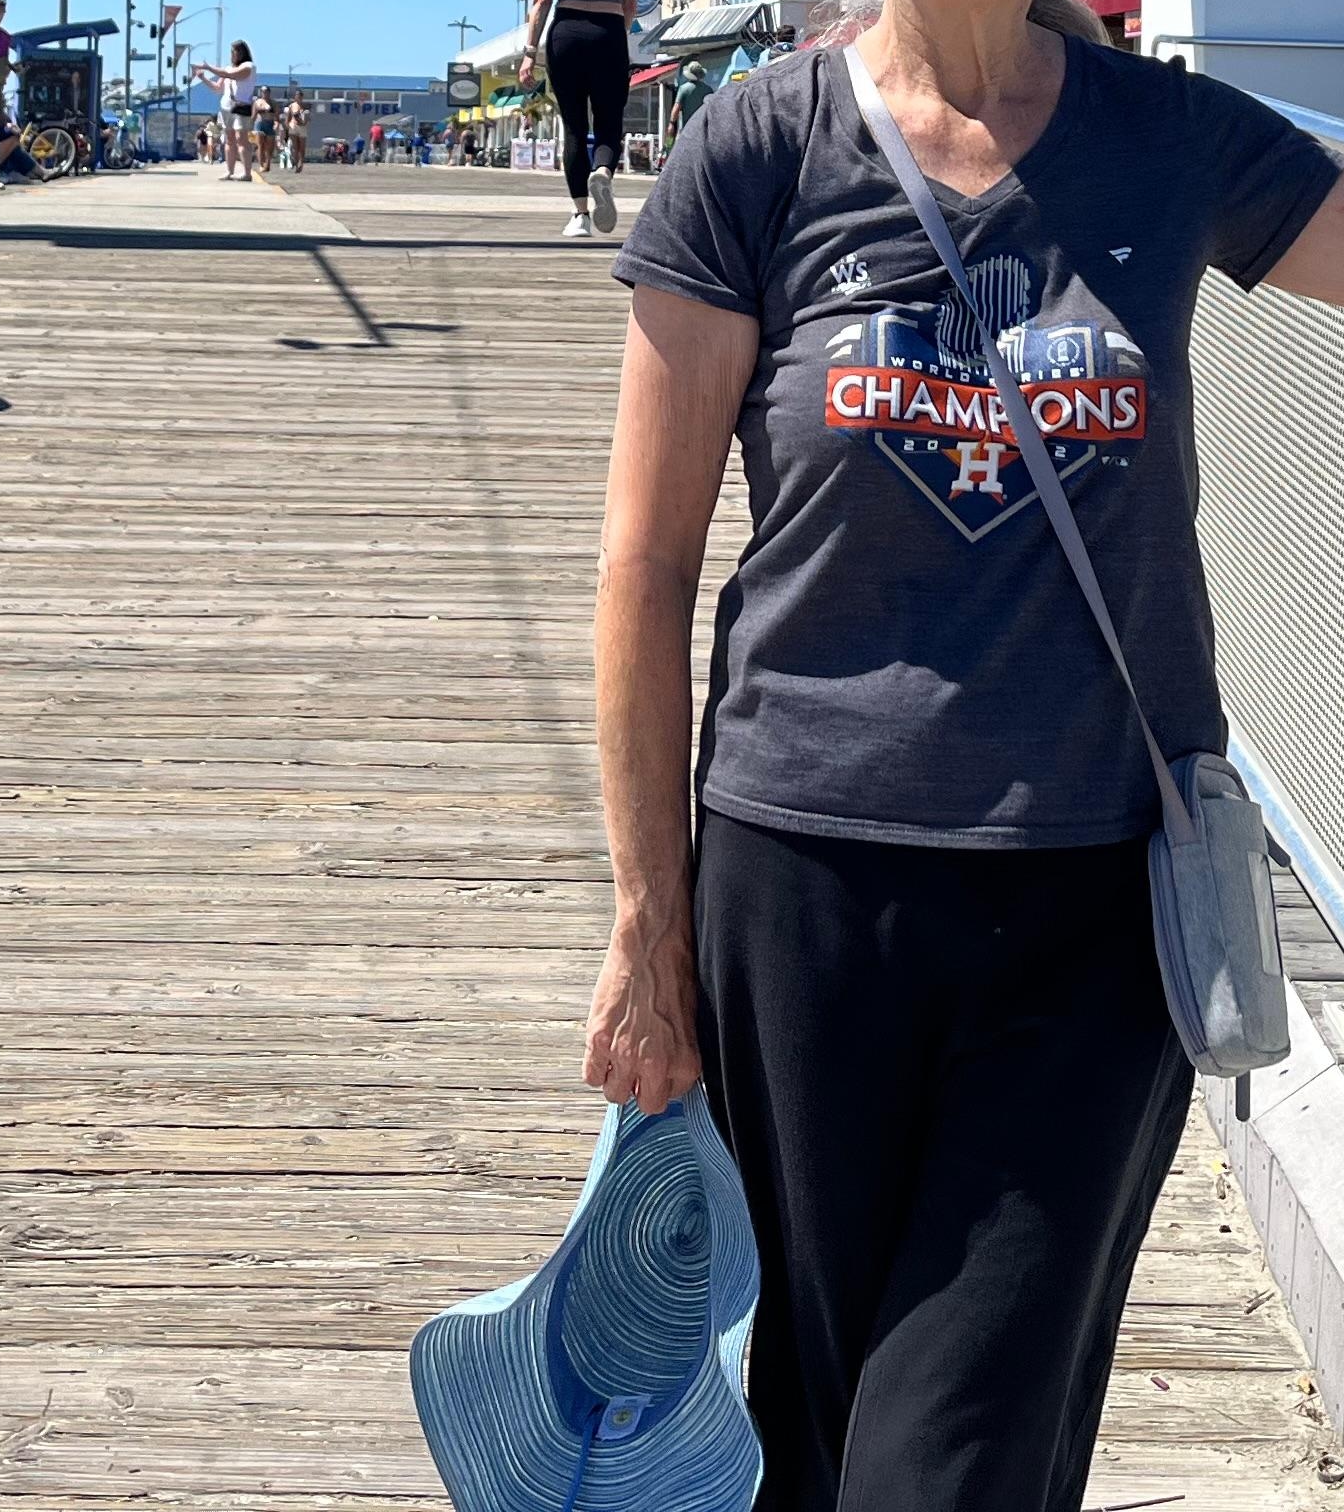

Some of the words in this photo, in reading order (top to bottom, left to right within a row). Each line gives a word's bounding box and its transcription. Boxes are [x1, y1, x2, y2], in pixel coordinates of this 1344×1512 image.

[829, 261, 868, 284] WS
[890, 356, 971, 383] WORLD
[830, 373, 1138, 434] CHAMPONS
